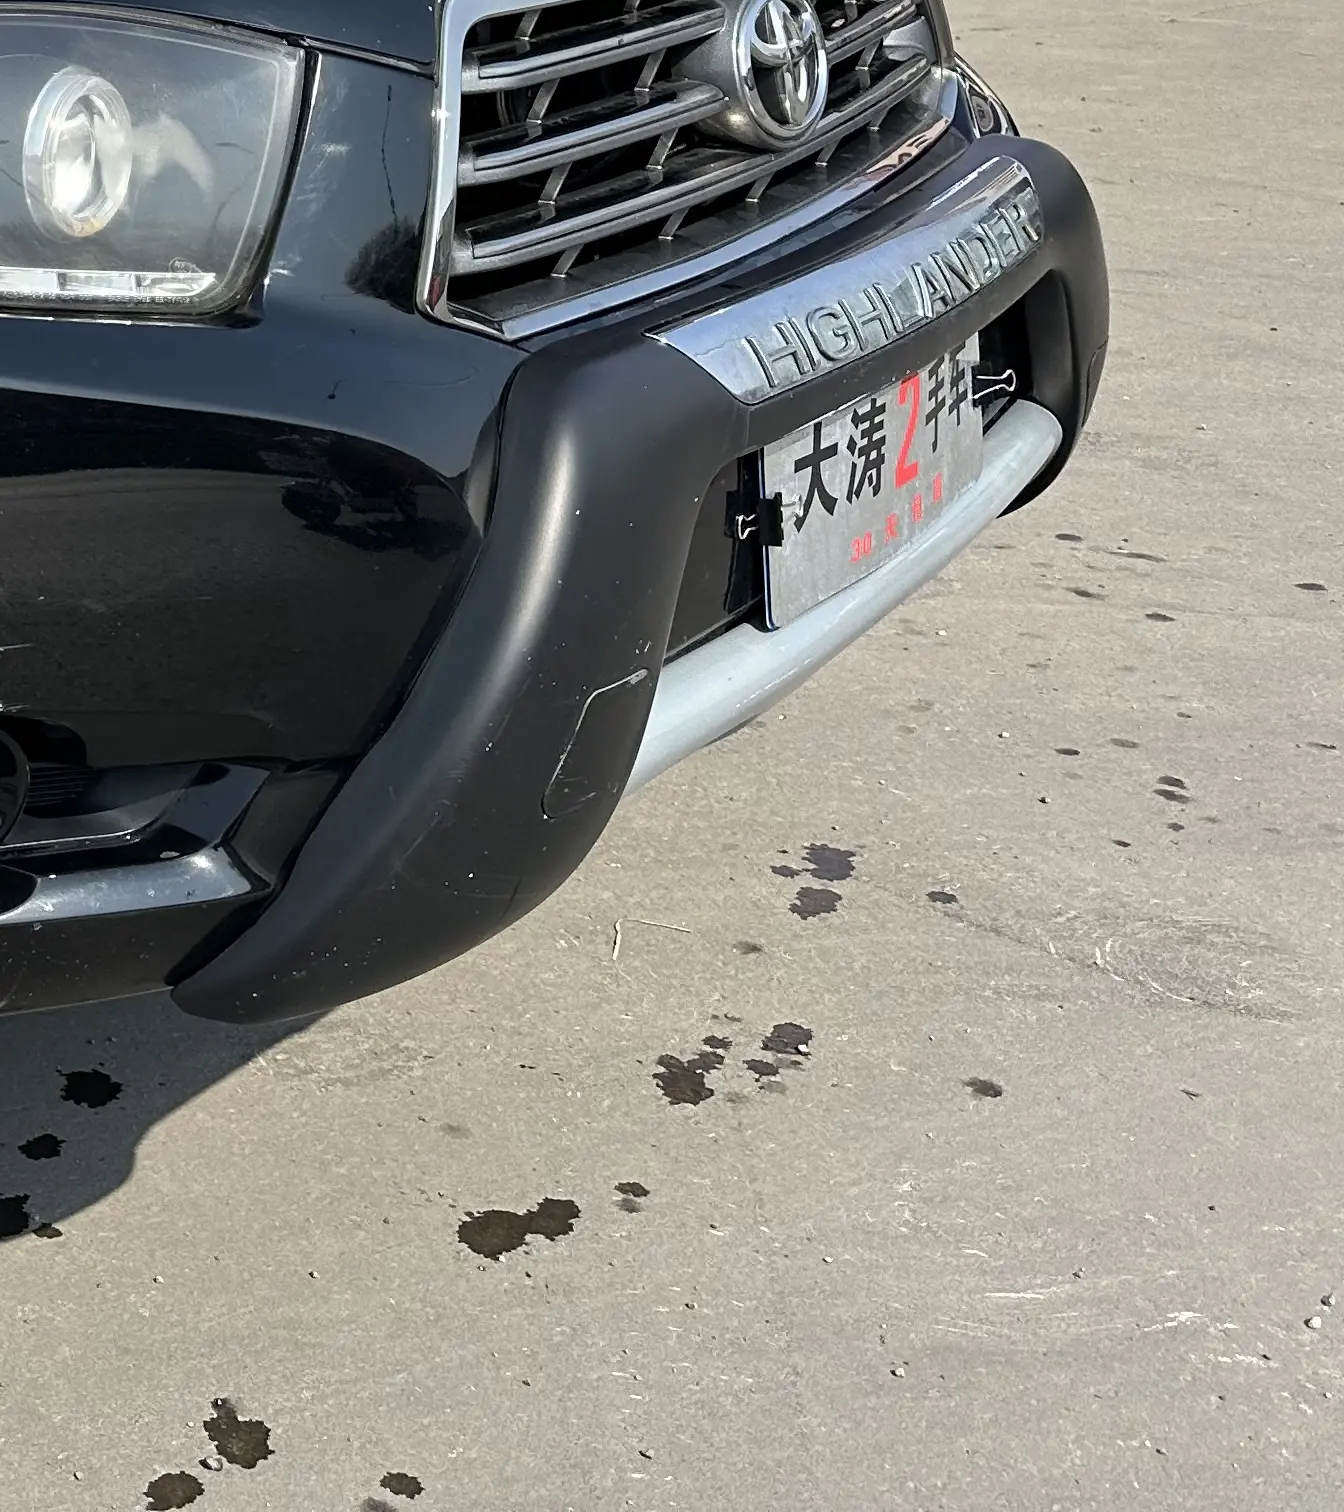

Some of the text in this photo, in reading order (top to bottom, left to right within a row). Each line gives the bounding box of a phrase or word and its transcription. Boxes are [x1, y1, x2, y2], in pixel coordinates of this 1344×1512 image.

[745, 198, 1040, 389] HIGHLANDER
[793, 341, 968, 533] 大涛2手车
